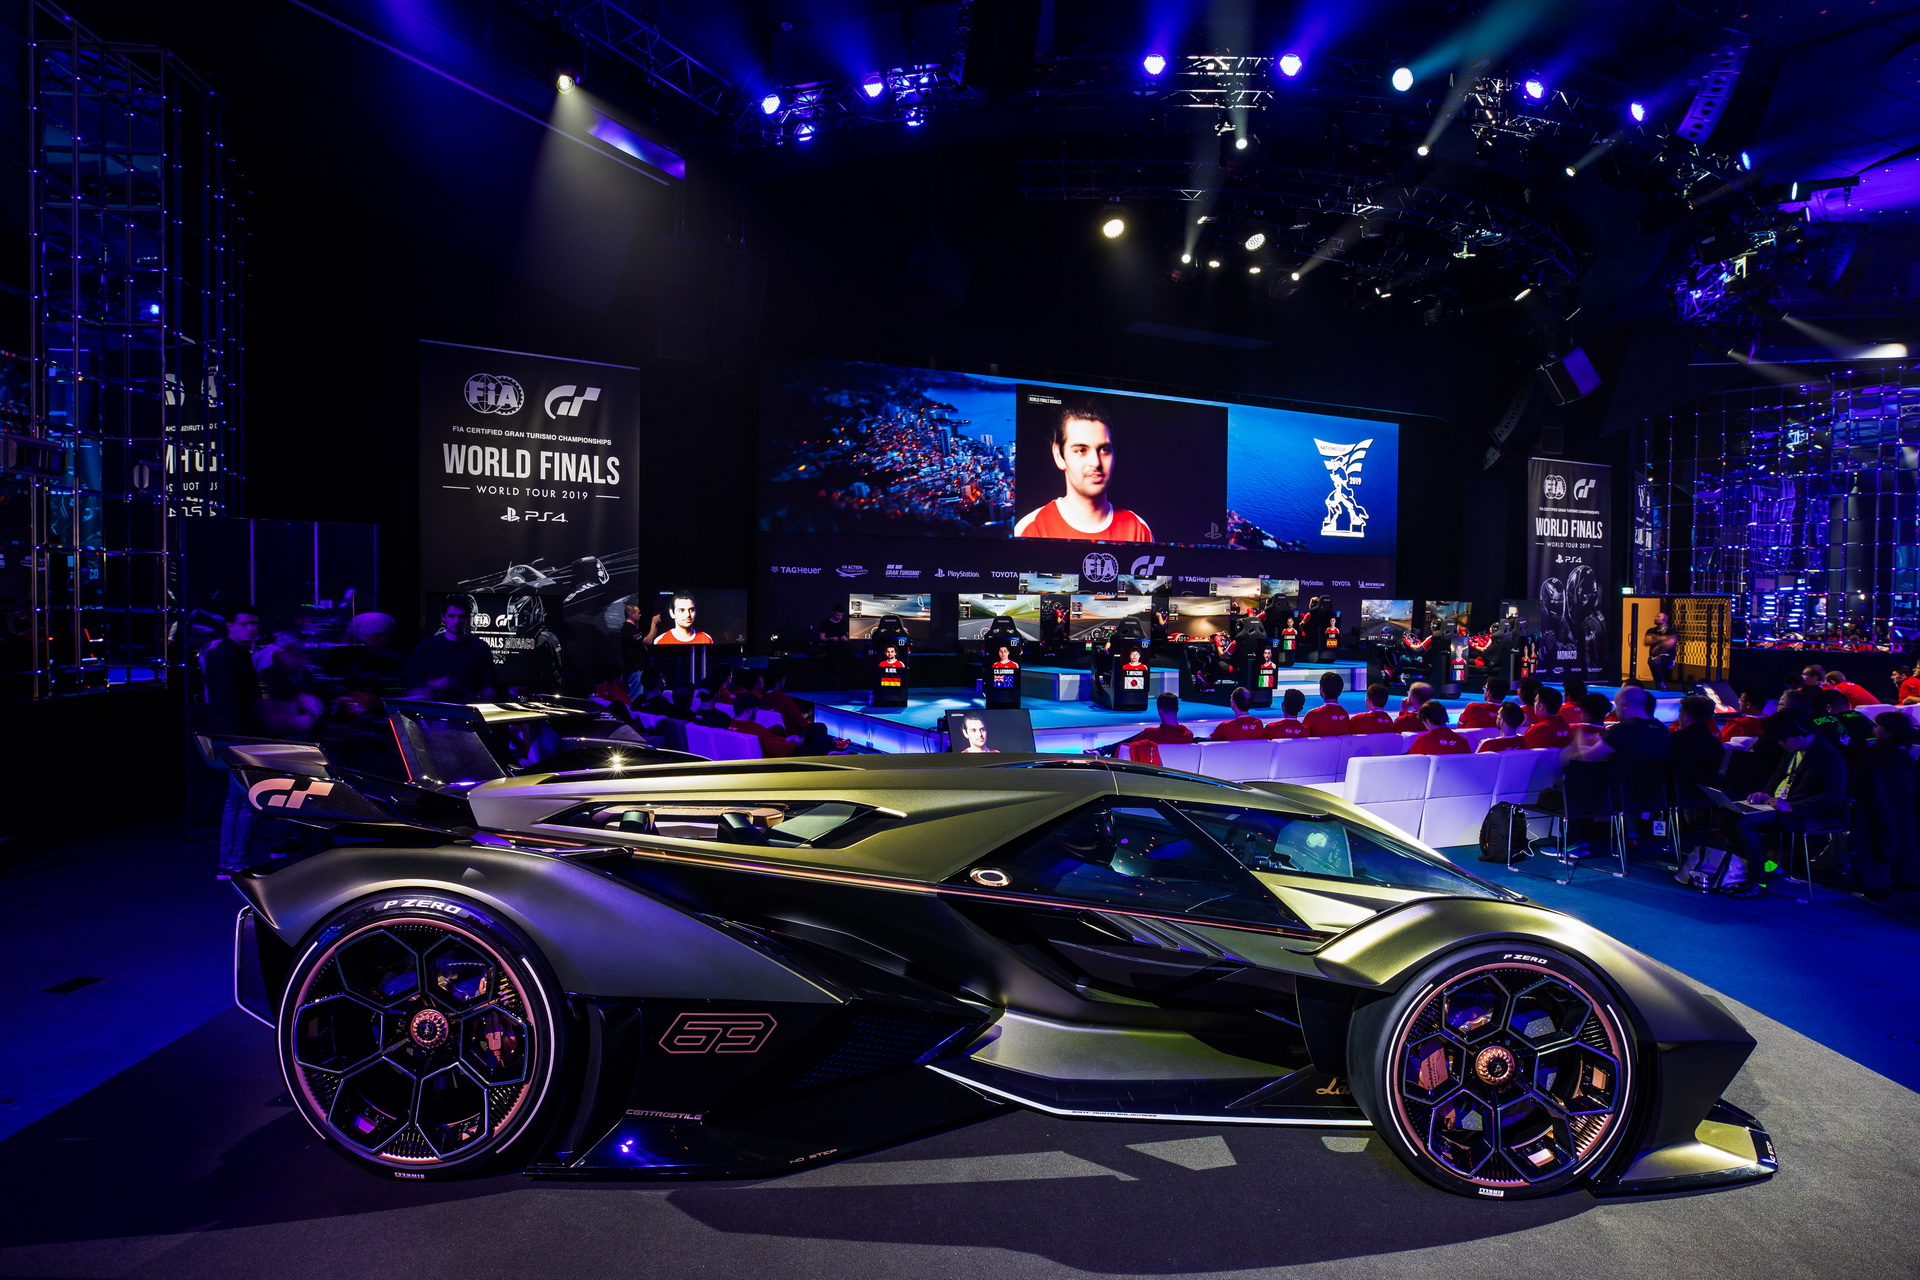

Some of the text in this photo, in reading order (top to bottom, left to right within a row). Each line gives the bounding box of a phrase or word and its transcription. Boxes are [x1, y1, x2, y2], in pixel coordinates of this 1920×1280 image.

[468, 381, 518, 408] FIA
[452, 425, 612, 446] FIA CERTIFIED GRAN TURISMO CHAMPIONSHIPS
[443, 443, 620, 485] WORLD FINALS
[476, 485, 589, 501] WORLD TOUR 2019
[525, 511, 568, 523] PS4
[1535, 517, 1603, 539] WORLD FINALS
[947, 570, 980, 579] PlayStation
[1085, 558, 1115, 576] FIA
[504, 638, 535, 650] MONACO
[1557, 650, 1577, 660] MONACO
[383, 899, 462, 915] P ZERO
[1513, 954, 1548, 964] ZERO
[658, 1013, 778, 1054] 63
[625, 1108, 703, 1121] CENTROSTILE
[789, 1147, 838, 1165] NO STEP
